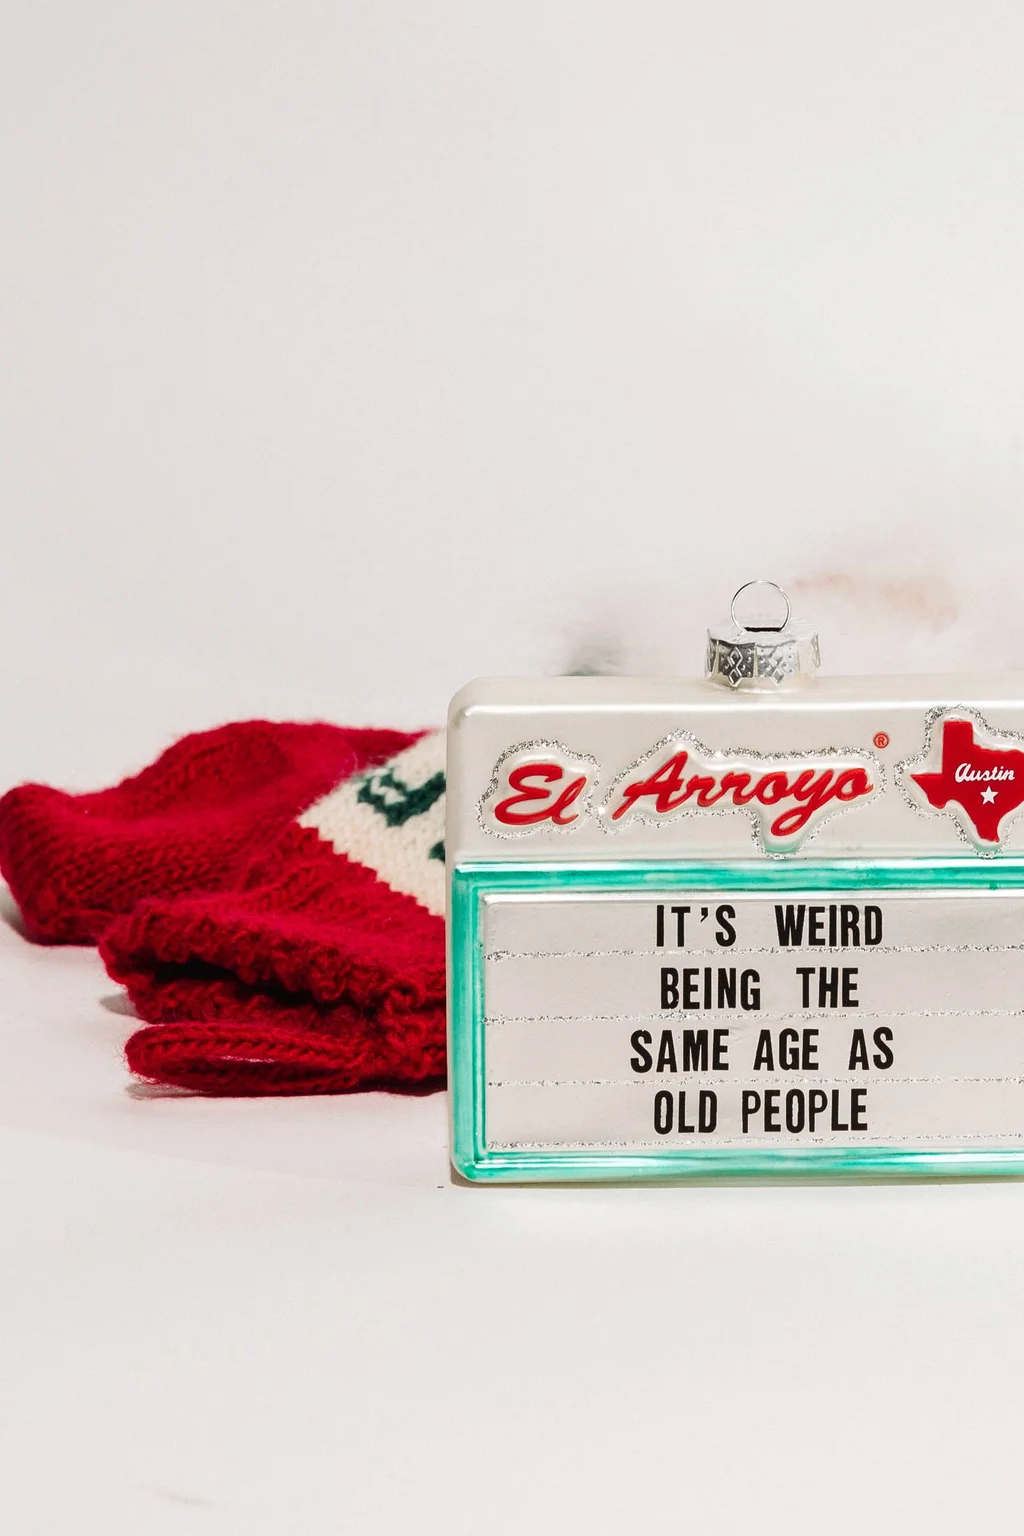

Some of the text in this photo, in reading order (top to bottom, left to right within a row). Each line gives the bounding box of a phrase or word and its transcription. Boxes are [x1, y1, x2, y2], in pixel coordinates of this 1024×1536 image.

[493, 750, 874, 837] El Arroyo
[954, 762, 1015, 783] Austin
[656, 904, 883, 948] IT'S WEIRD
[660, 966, 859, 1011] BEING THE
[630, 1026, 894, 1074] SAME AGE AS
[653, 1088, 868, 1135] OLD PEOPLE
